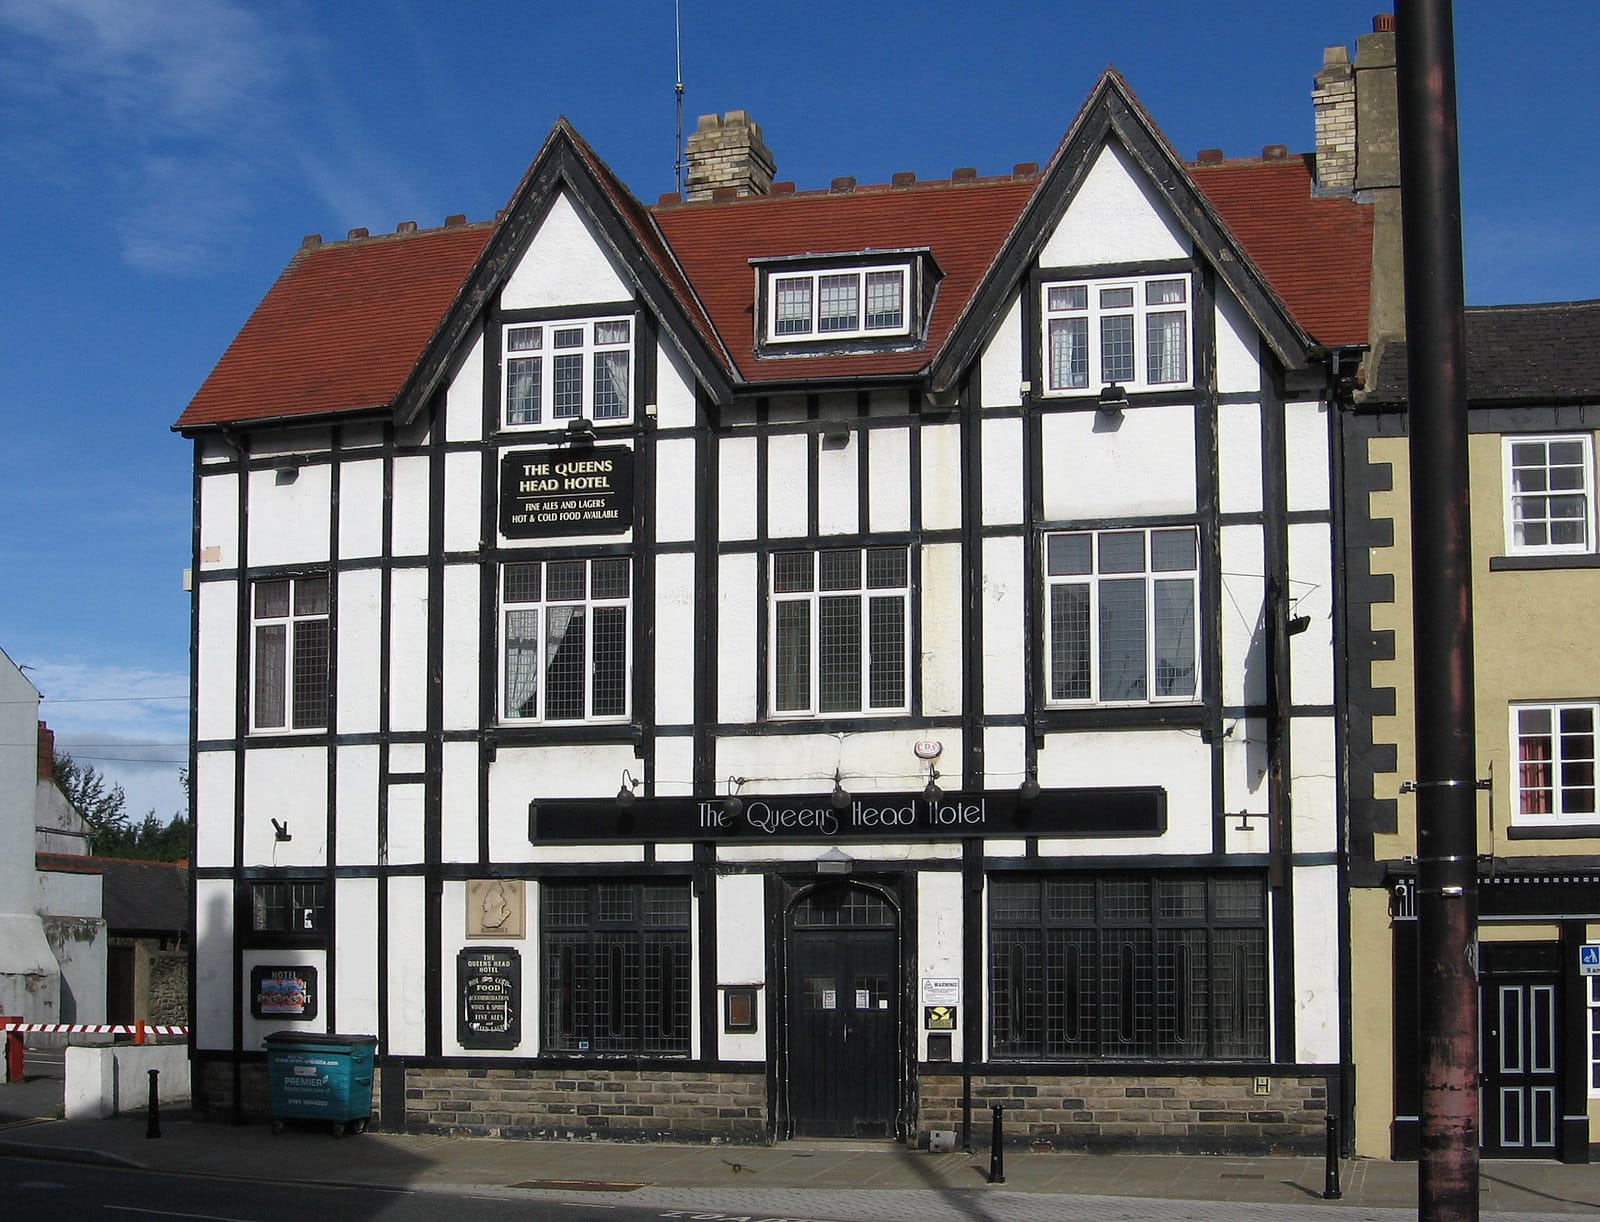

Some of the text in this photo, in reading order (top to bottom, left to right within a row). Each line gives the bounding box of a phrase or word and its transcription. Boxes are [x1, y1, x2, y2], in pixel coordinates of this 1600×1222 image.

[523, 460, 613, 476] THE QUEENS
[520, 476, 610, 492] HEAD HOTEL
[525, 499, 606, 511] FINE ALES AND LAGERS
[512, 510, 619, 523] HOT & COLD FOOD AVAILABLE
[698, 798, 985, 835] The Queens Head Hotel
[272, 971, 297, 979] HOTEL
[284, 1077, 323, 1087] PREMIER
